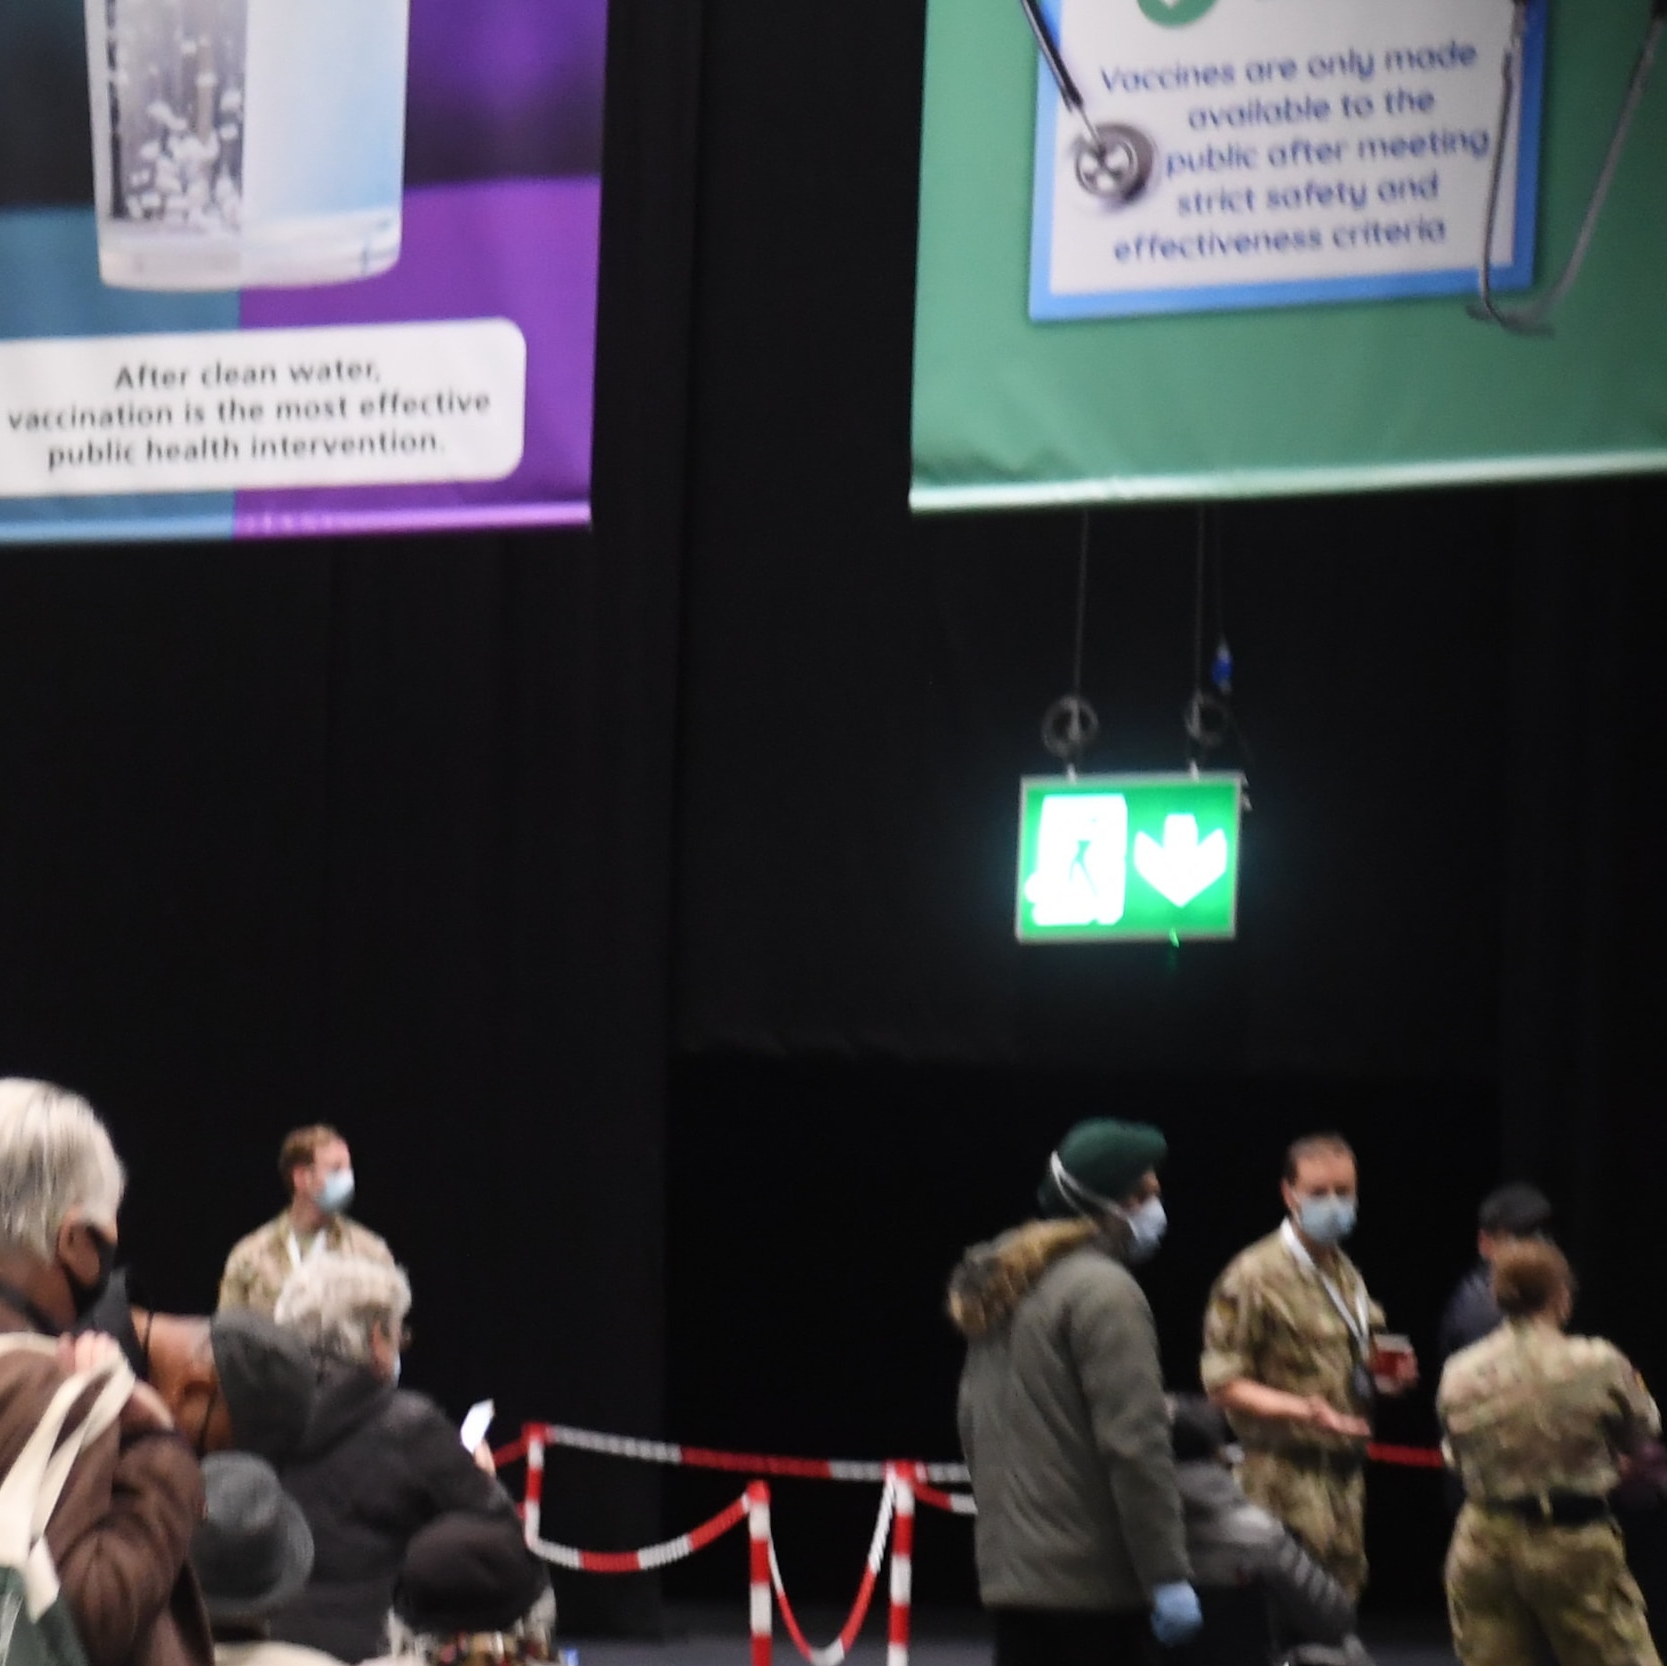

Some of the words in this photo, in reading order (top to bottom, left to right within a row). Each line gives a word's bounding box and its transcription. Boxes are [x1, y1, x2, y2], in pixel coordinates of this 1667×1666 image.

[1101, 63, 1235, 92] Vaccines
[1246, 57, 1297, 83] are
[1308, 48, 1375, 81] only
[1385, 39, 1477, 69] made
[1188, 96, 1331, 129] available
[1341, 95, 1374, 118] to
[1385, 87, 1435, 115] the
[1167, 144, 1257, 179] public
[1268, 138, 1346, 165] after
[1359, 130, 1490, 160] meeting
[1178, 188, 1255, 216] strict
[1267, 179, 1367, 211] safety
[1378, 169, 1438, 201] and
[1114, 228, 1322, 260] effectiveness
[1333, 215, 1446, 248] criteria
[115, 363, 187, 389] After
[201, 360, 276, 387] clean
[289, 360, 380, 384] water,
[8, 404, 173, 430] vaccination
[185, 400, 205, 423] is
[218, 397, 264, 422] the
[276, 397, 347, 419] most
[359, 391, 490, 415] effective
[48, 440, 133, 472] public
[146, 436, 239, 461] health
[252, 430, 445, 459] intervention.
